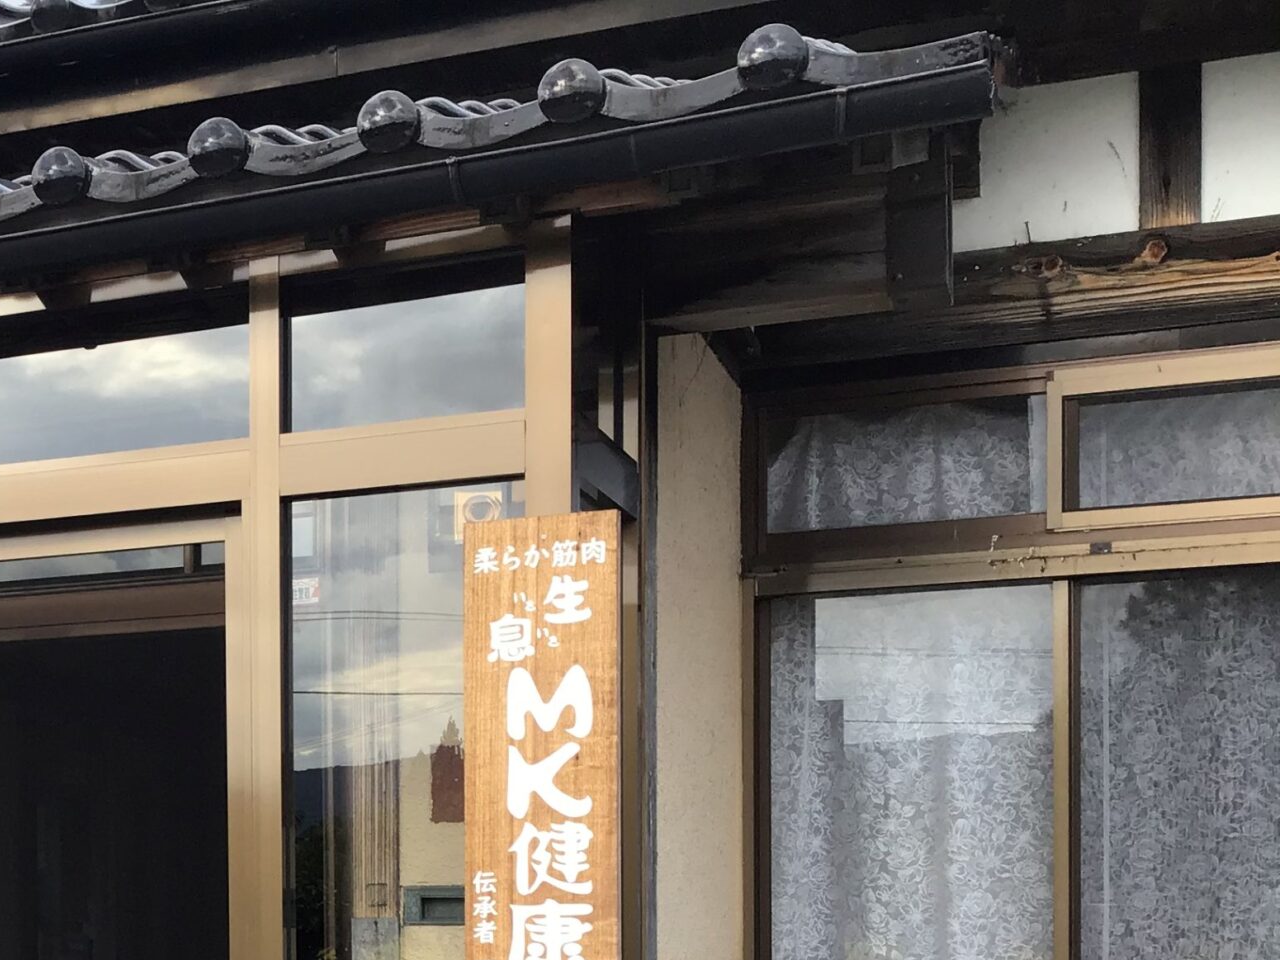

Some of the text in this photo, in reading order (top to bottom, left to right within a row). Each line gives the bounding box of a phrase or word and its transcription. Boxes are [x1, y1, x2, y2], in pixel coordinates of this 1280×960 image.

[473, 537, 607, 574] 柔らか筋肉
[472, 870, 498, 944] 伝承者
